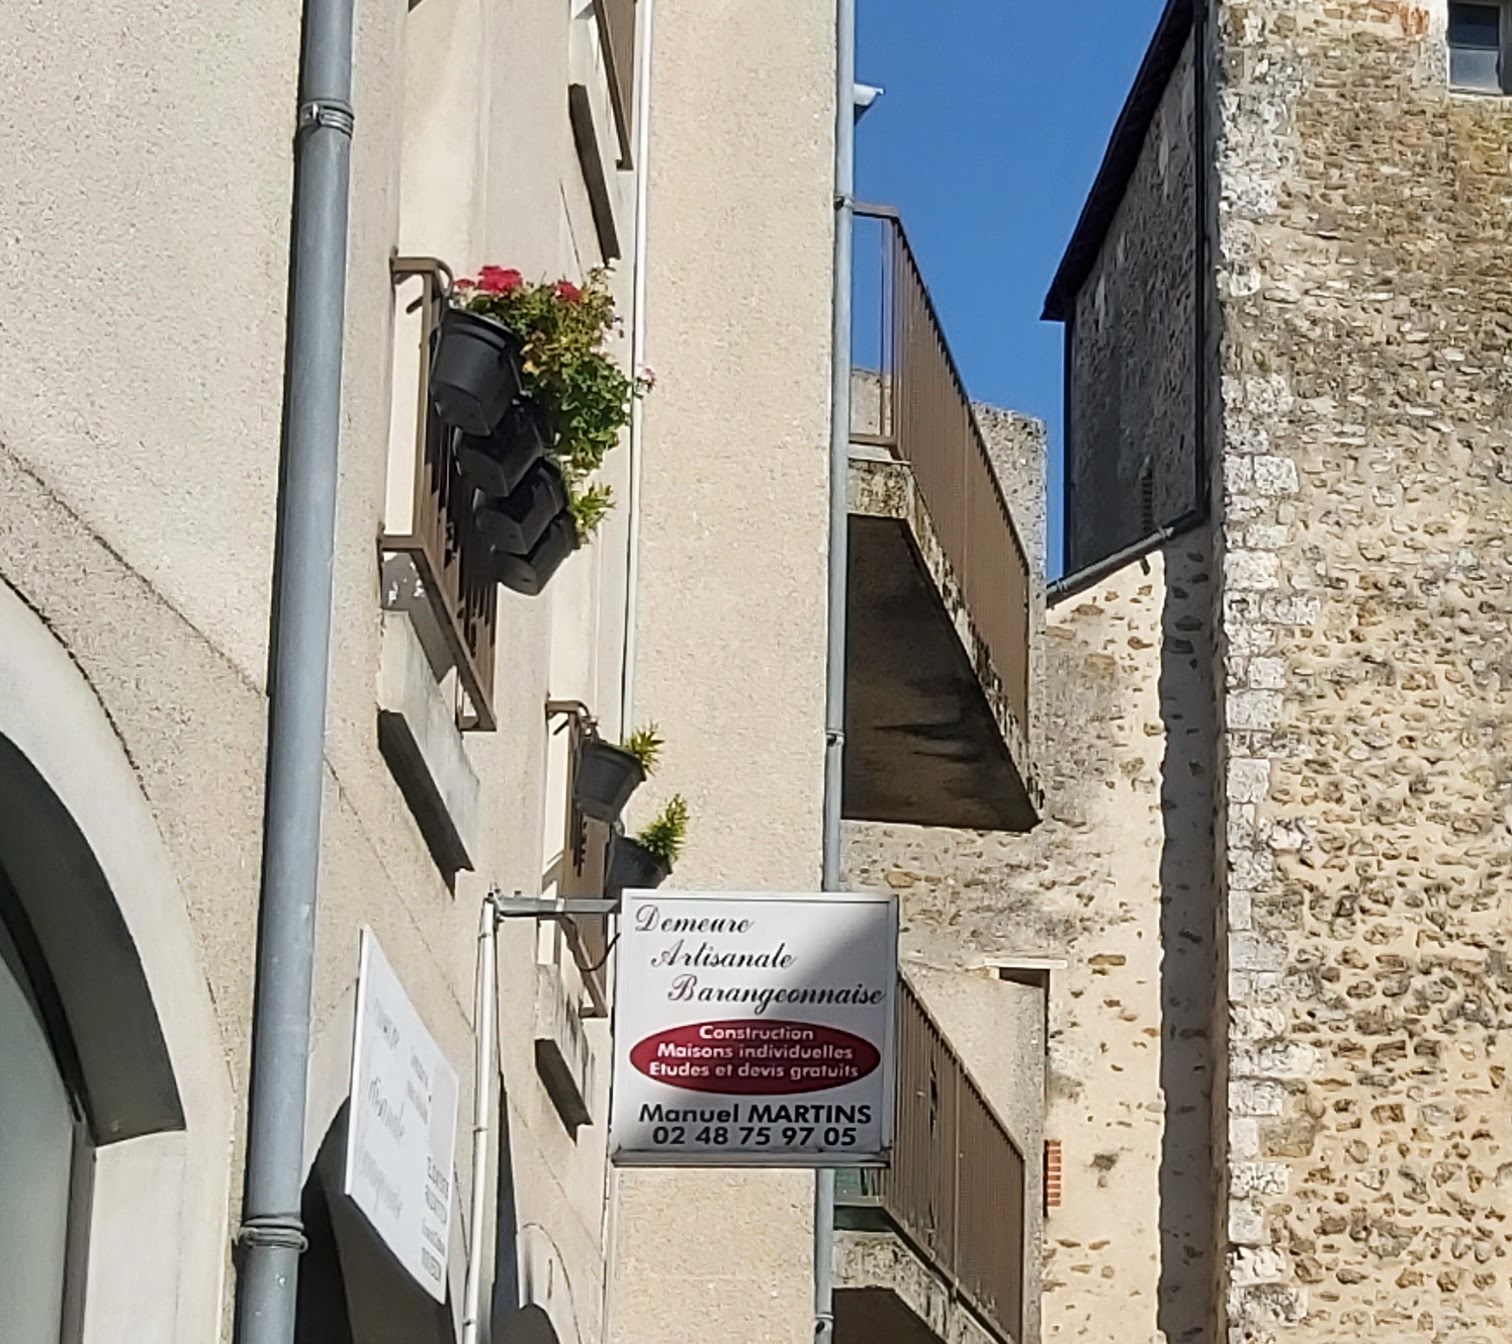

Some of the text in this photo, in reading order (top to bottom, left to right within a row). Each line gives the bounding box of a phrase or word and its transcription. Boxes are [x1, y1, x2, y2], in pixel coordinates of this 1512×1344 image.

[635, 904, 753, 933] Demeure
[651, 939, 797, 968] Artisanale
[667, 973, 885, 1014] Barangeonnaise
[699, 1025, 813, 1040] Construction
[657, 1043, 854, 1059] Maisons individuelles
[649, 1061, 859, 1080] Etudes et devis gratuits
[639, 1103, 872, 1124] Manuel MARTINS
[653, 1126, 857, 1146] 02 48 75 97 05
